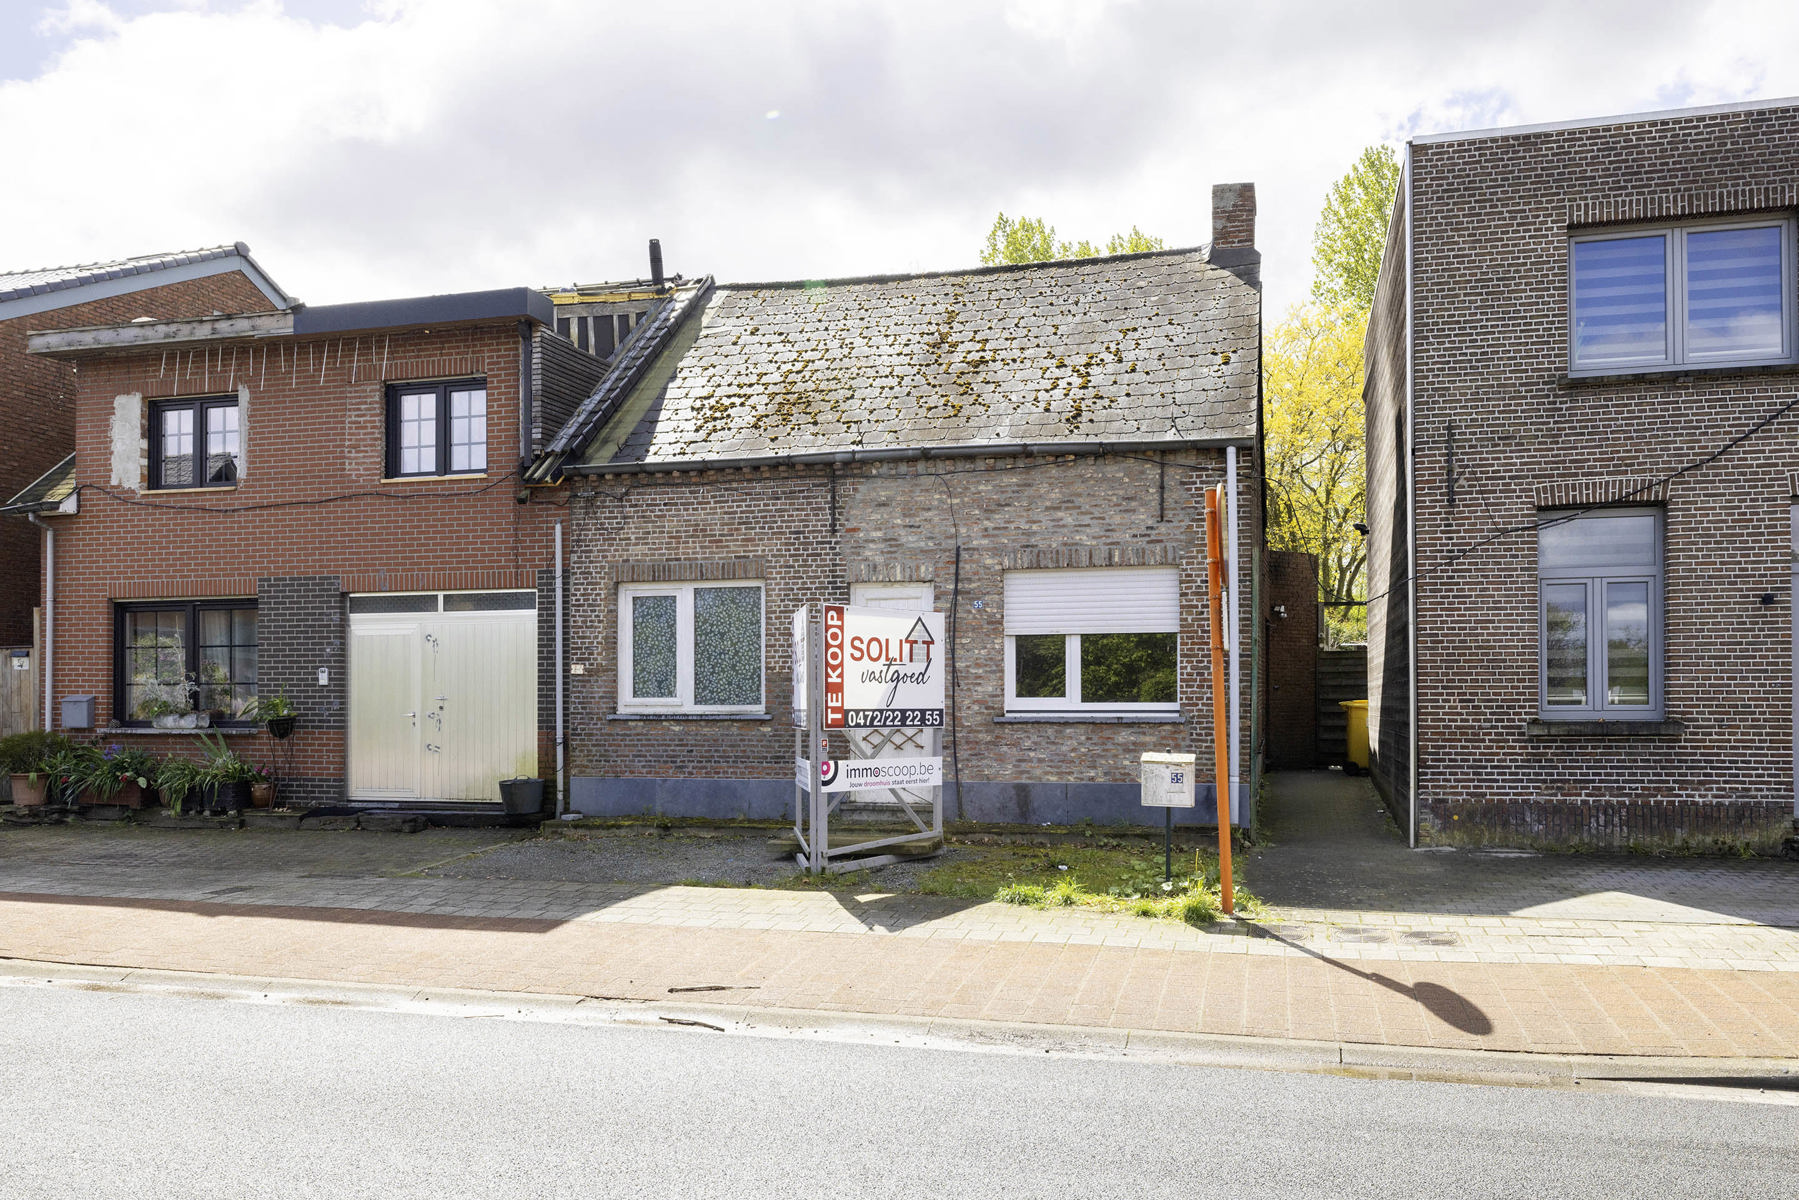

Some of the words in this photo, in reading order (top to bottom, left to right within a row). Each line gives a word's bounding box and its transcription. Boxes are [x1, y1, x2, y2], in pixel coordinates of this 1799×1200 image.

[827, 610, 843, 683] KOOP
[849, 635, 935, 663] SOLITT
[861, 656, 932, 707] vastgoed
[827, 692, 842, 725] TE
[848, 710, 901, 727] 0472/22
[906, 710, 921, 725] 22
[925, 710, 940, 725] 55
[846, 762, 934, 779] immoscoop.be
[1171, 773, 1183, 783] 55
